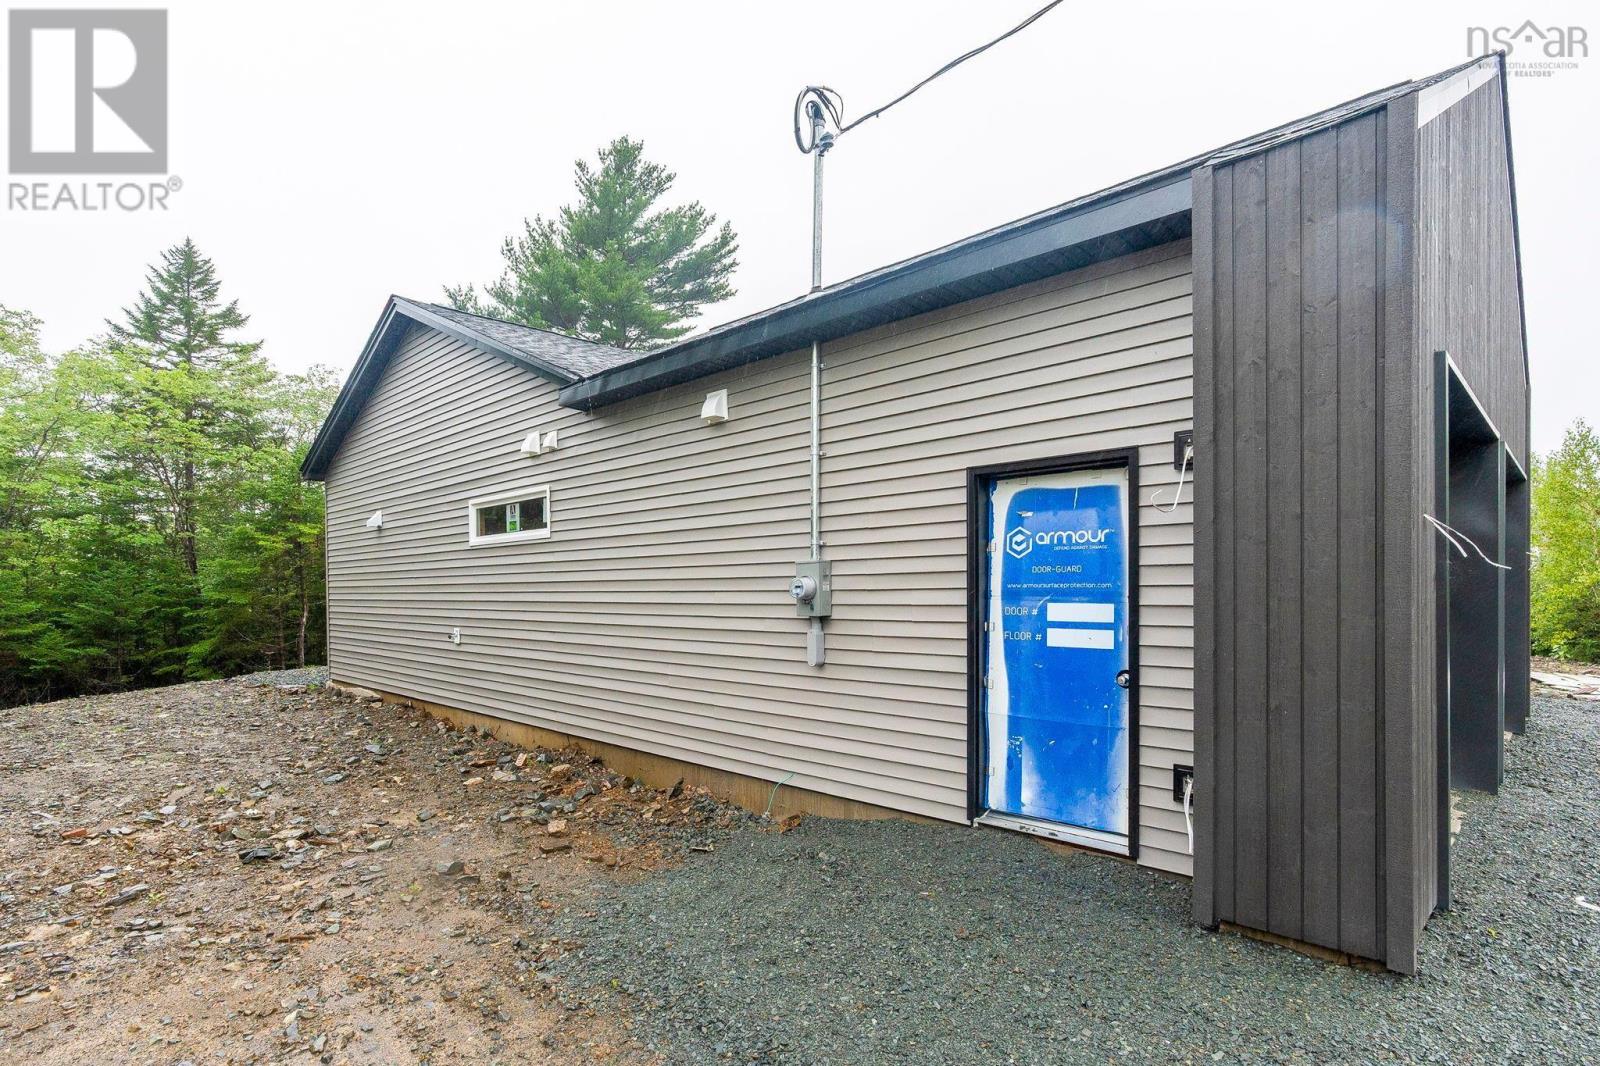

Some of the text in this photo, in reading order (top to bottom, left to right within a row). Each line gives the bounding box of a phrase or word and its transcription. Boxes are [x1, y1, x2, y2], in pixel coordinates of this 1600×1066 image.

[1031, 565, 1082, 574] DOOR-GUARD
[1004, 606, 1038, 616] DOOR #
[1004, 631, 1042, 641] FLOOR #
